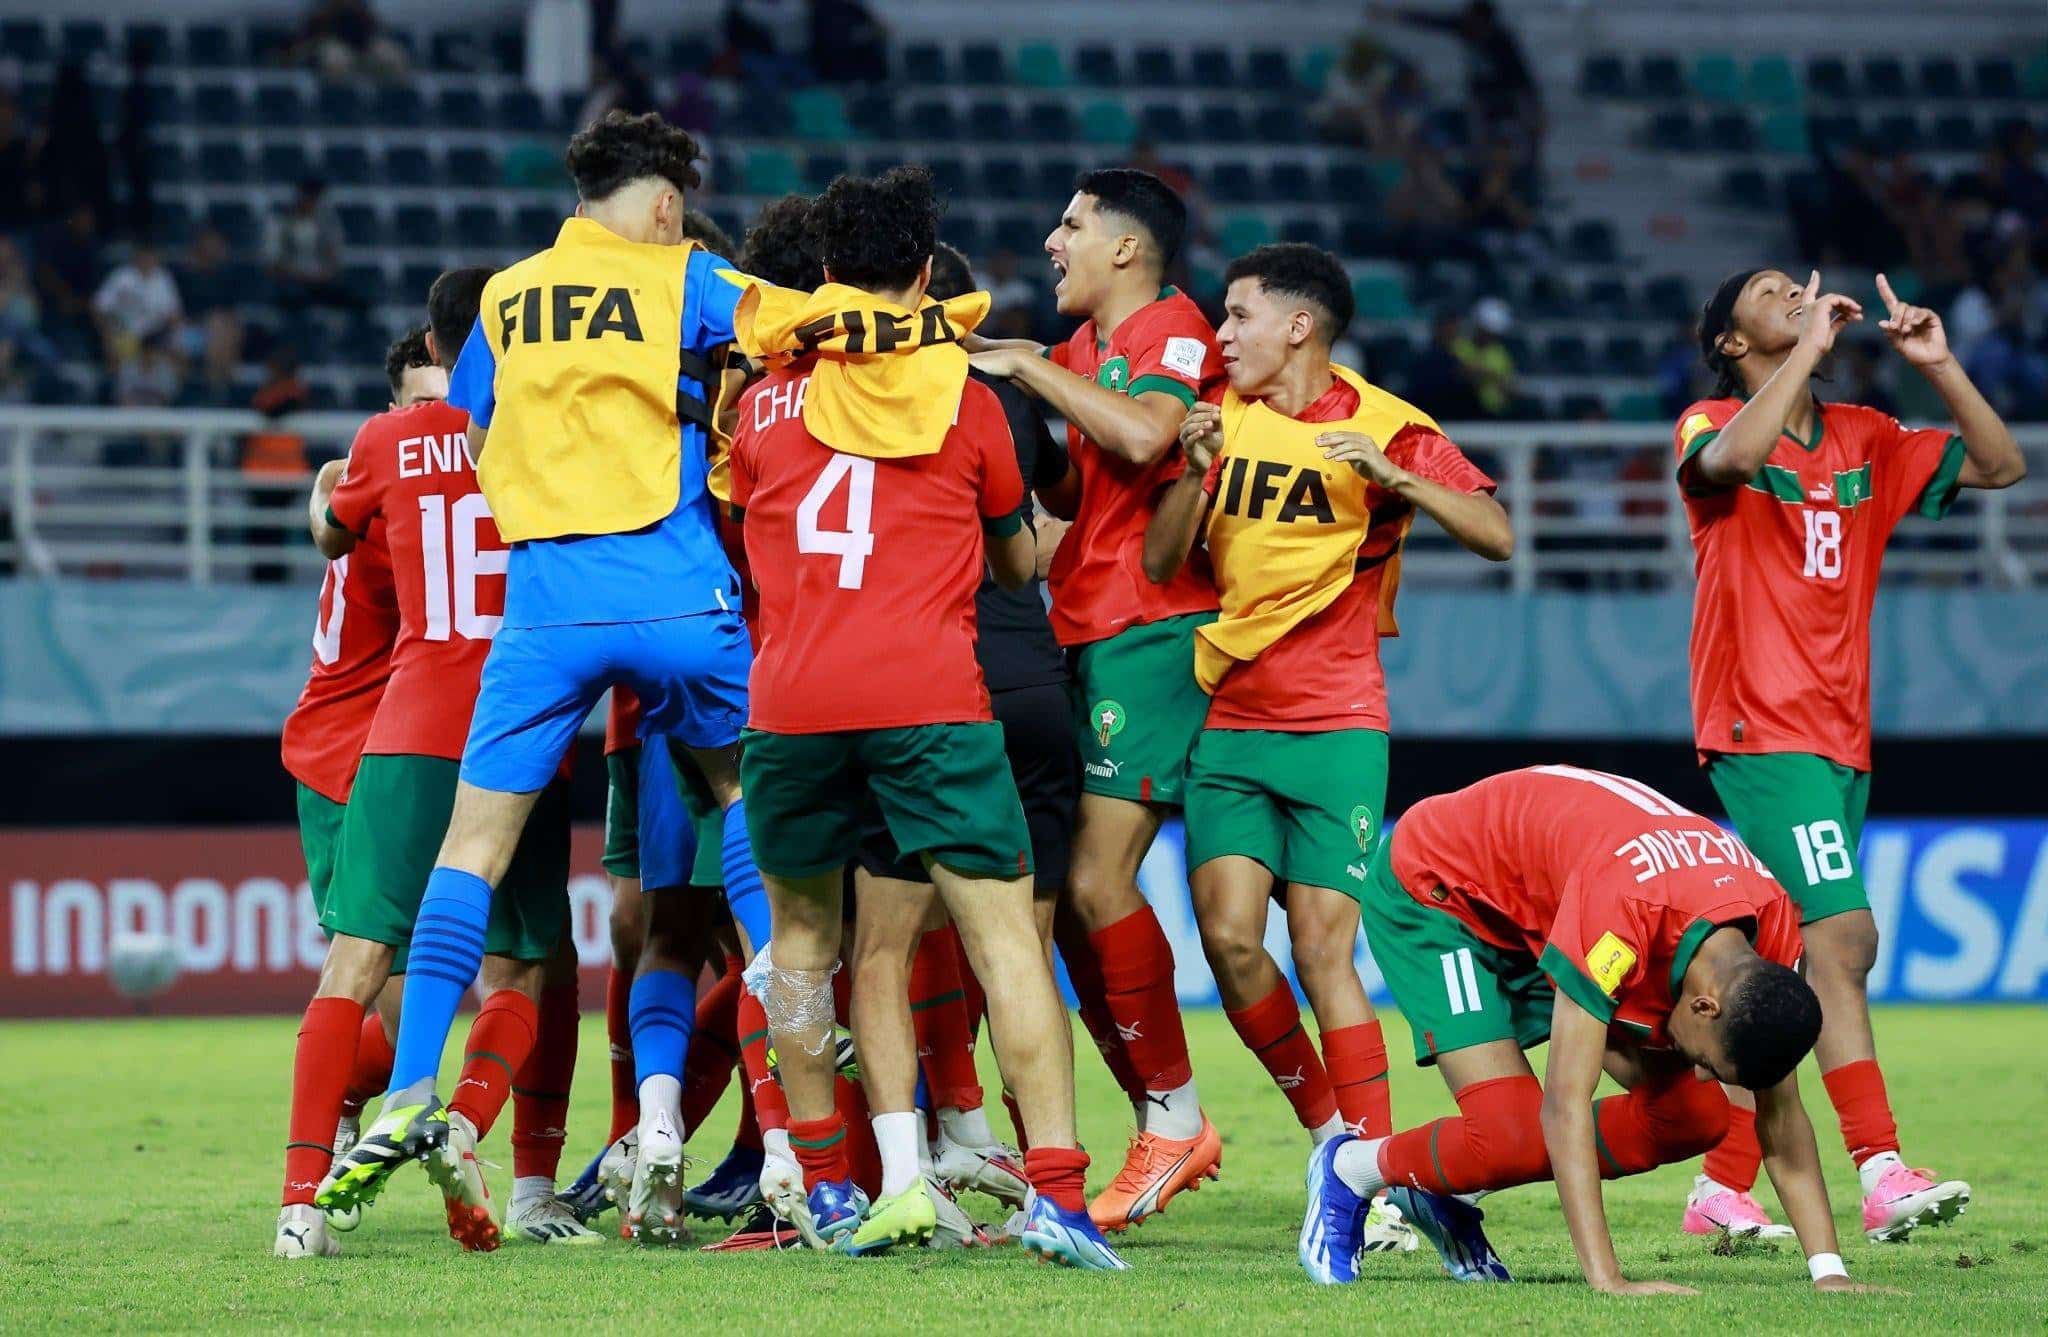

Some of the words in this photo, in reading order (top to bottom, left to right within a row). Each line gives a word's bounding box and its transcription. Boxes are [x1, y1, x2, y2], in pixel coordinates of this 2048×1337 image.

[499, 285, 644, 354] FIFA
[795, 304, 960, 353] FIFA
[796, 453, 876, 591] 4
[1802, 509, 1842, 579] 18
[1084, 762, 1114, 778] PUMA
[1791, 819, 1854, 887] 18
[1439, 947, 1483, 1016] 11
